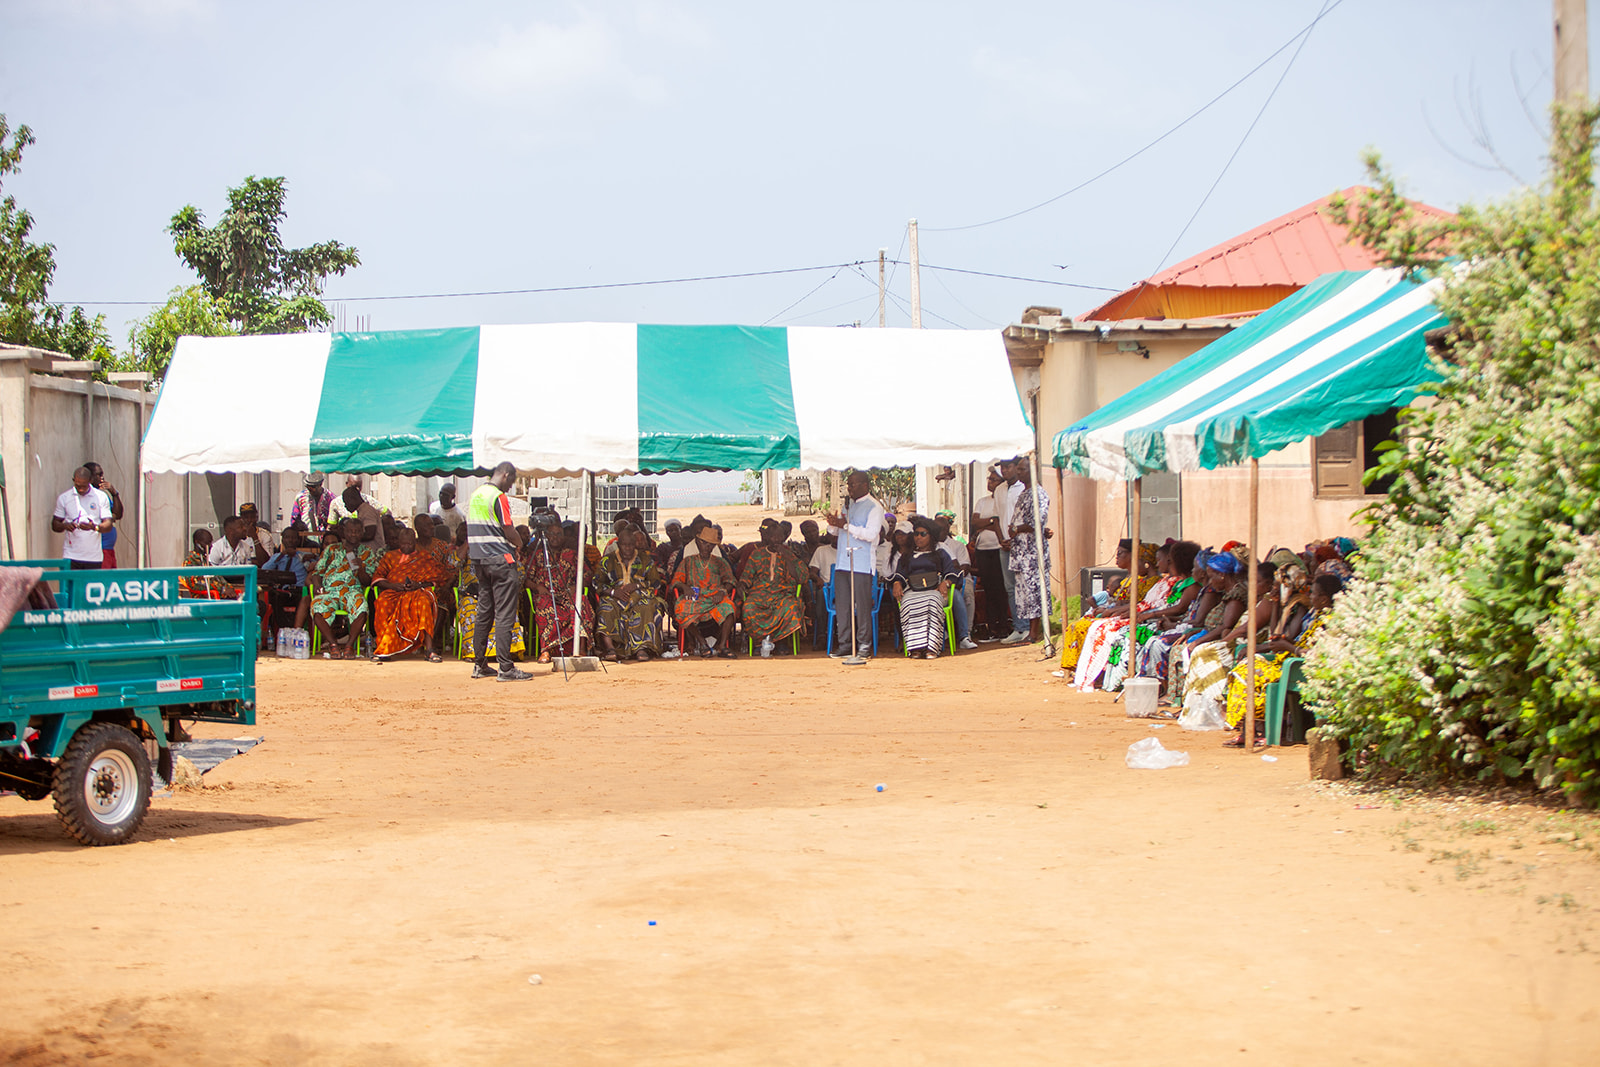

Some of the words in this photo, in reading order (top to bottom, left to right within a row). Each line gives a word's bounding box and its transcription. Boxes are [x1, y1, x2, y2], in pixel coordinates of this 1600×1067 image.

[85, 580, 169, 605] QASKI
[24, 612, 46, 623] Don
[47, 612, 62, 623] de
[128, 605, 192, 619] IMMOBILIER
[181, 679, 201, 688] QASKI
[75, 686, 96, 695] QASKI
